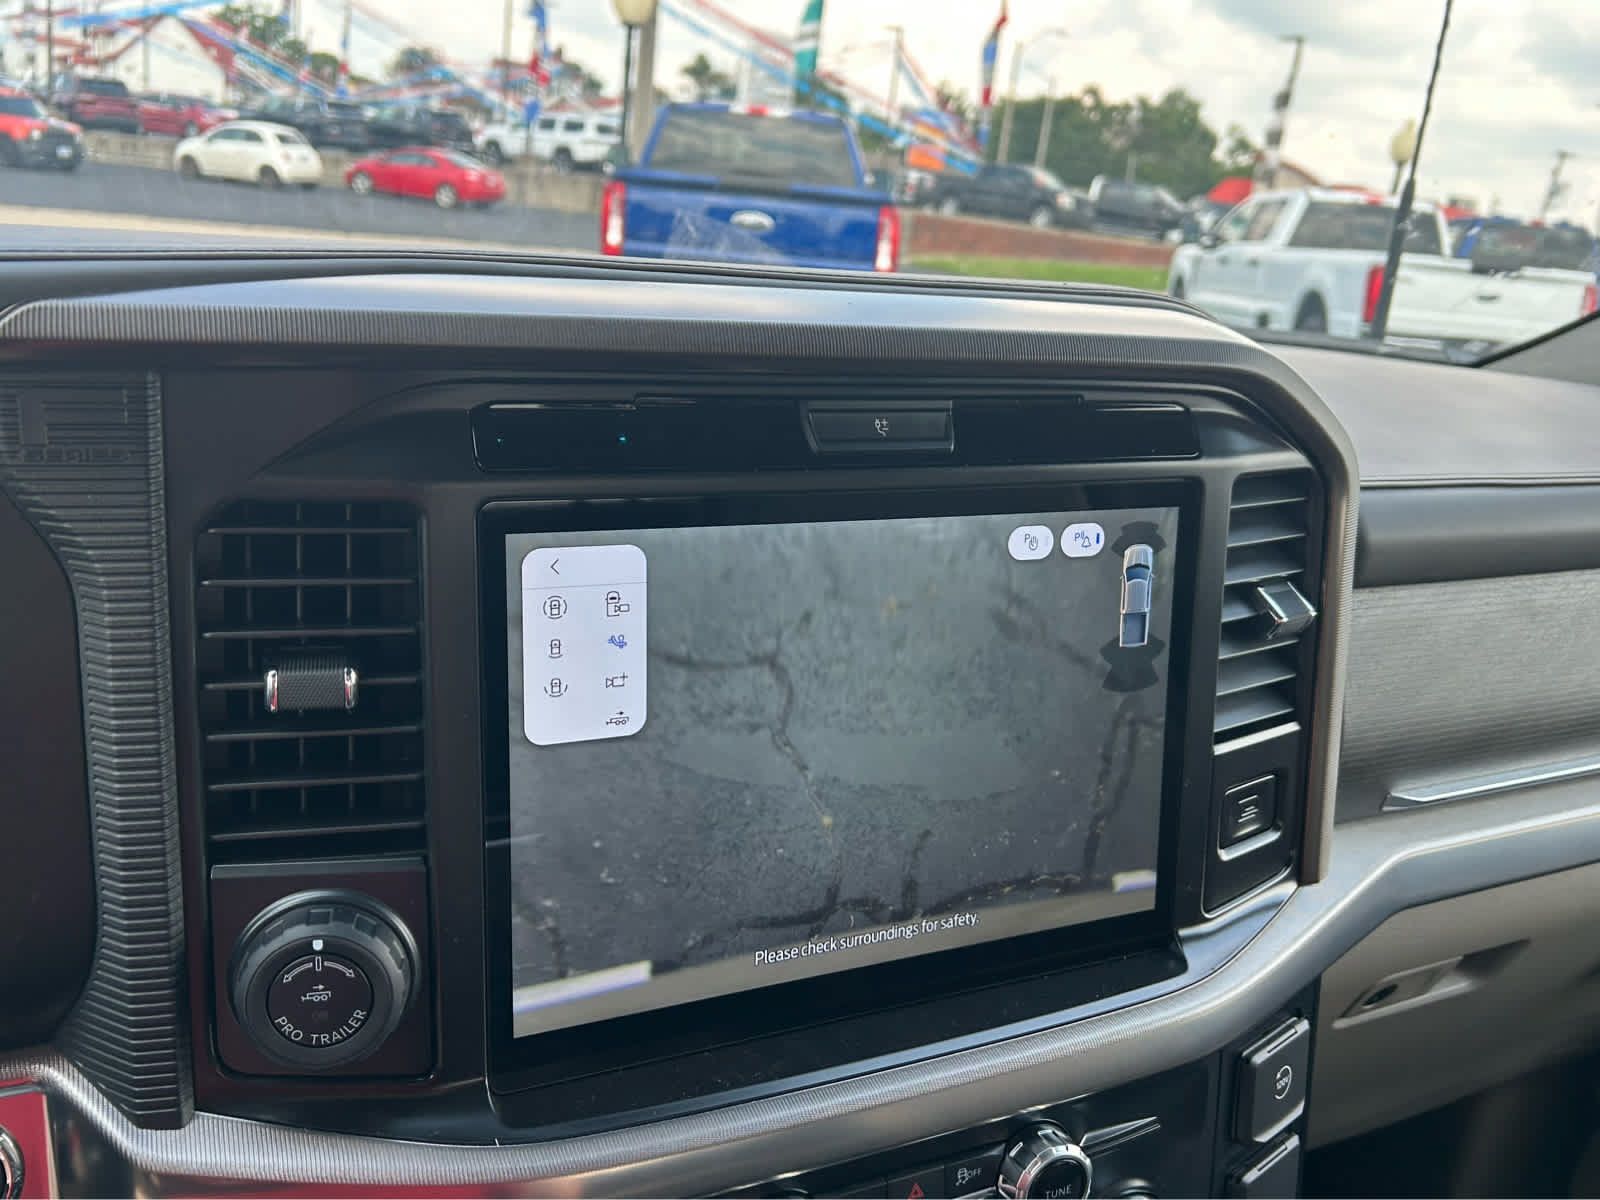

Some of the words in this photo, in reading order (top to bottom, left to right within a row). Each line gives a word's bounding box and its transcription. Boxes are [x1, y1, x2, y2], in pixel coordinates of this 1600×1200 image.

[754, 947, 799, 965] Please
[801, 936, 837, 957] check
[840, 924, 919, 949] surroundings
[921, 919, 938, 933] for
[941, 912, 980, 929] safety.
[274, 1016, 304, 1041] PRO
[310, 1009, 367, 1045] TRAILER
[967, 1167, 982, 1178] OFF
[1045, 1184, 1072, 1199] TUNE
